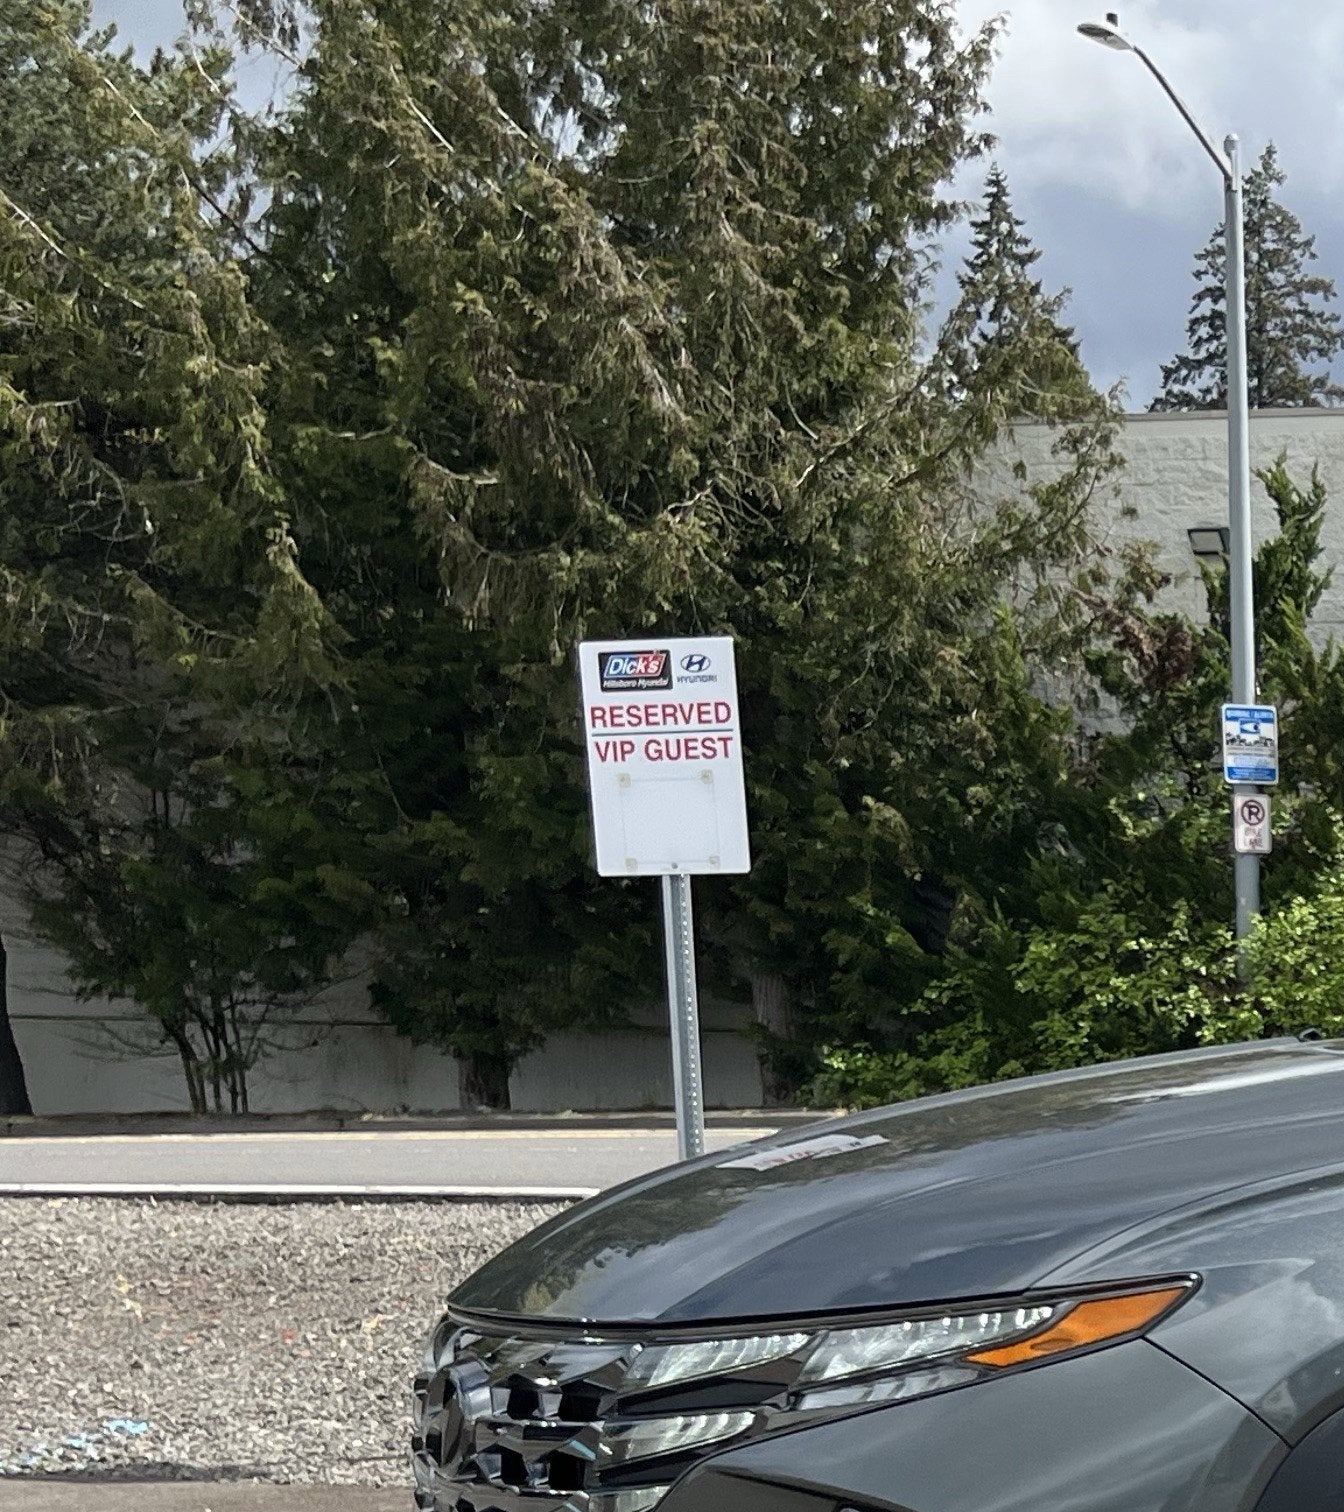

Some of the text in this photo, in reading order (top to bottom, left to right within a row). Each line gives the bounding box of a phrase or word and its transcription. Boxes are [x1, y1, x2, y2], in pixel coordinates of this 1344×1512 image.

[608, 656, 660, 675] Dick's
[590, 702, 732, 728] RESERVED
[595, 737, 733, 763] VIP GUEST
